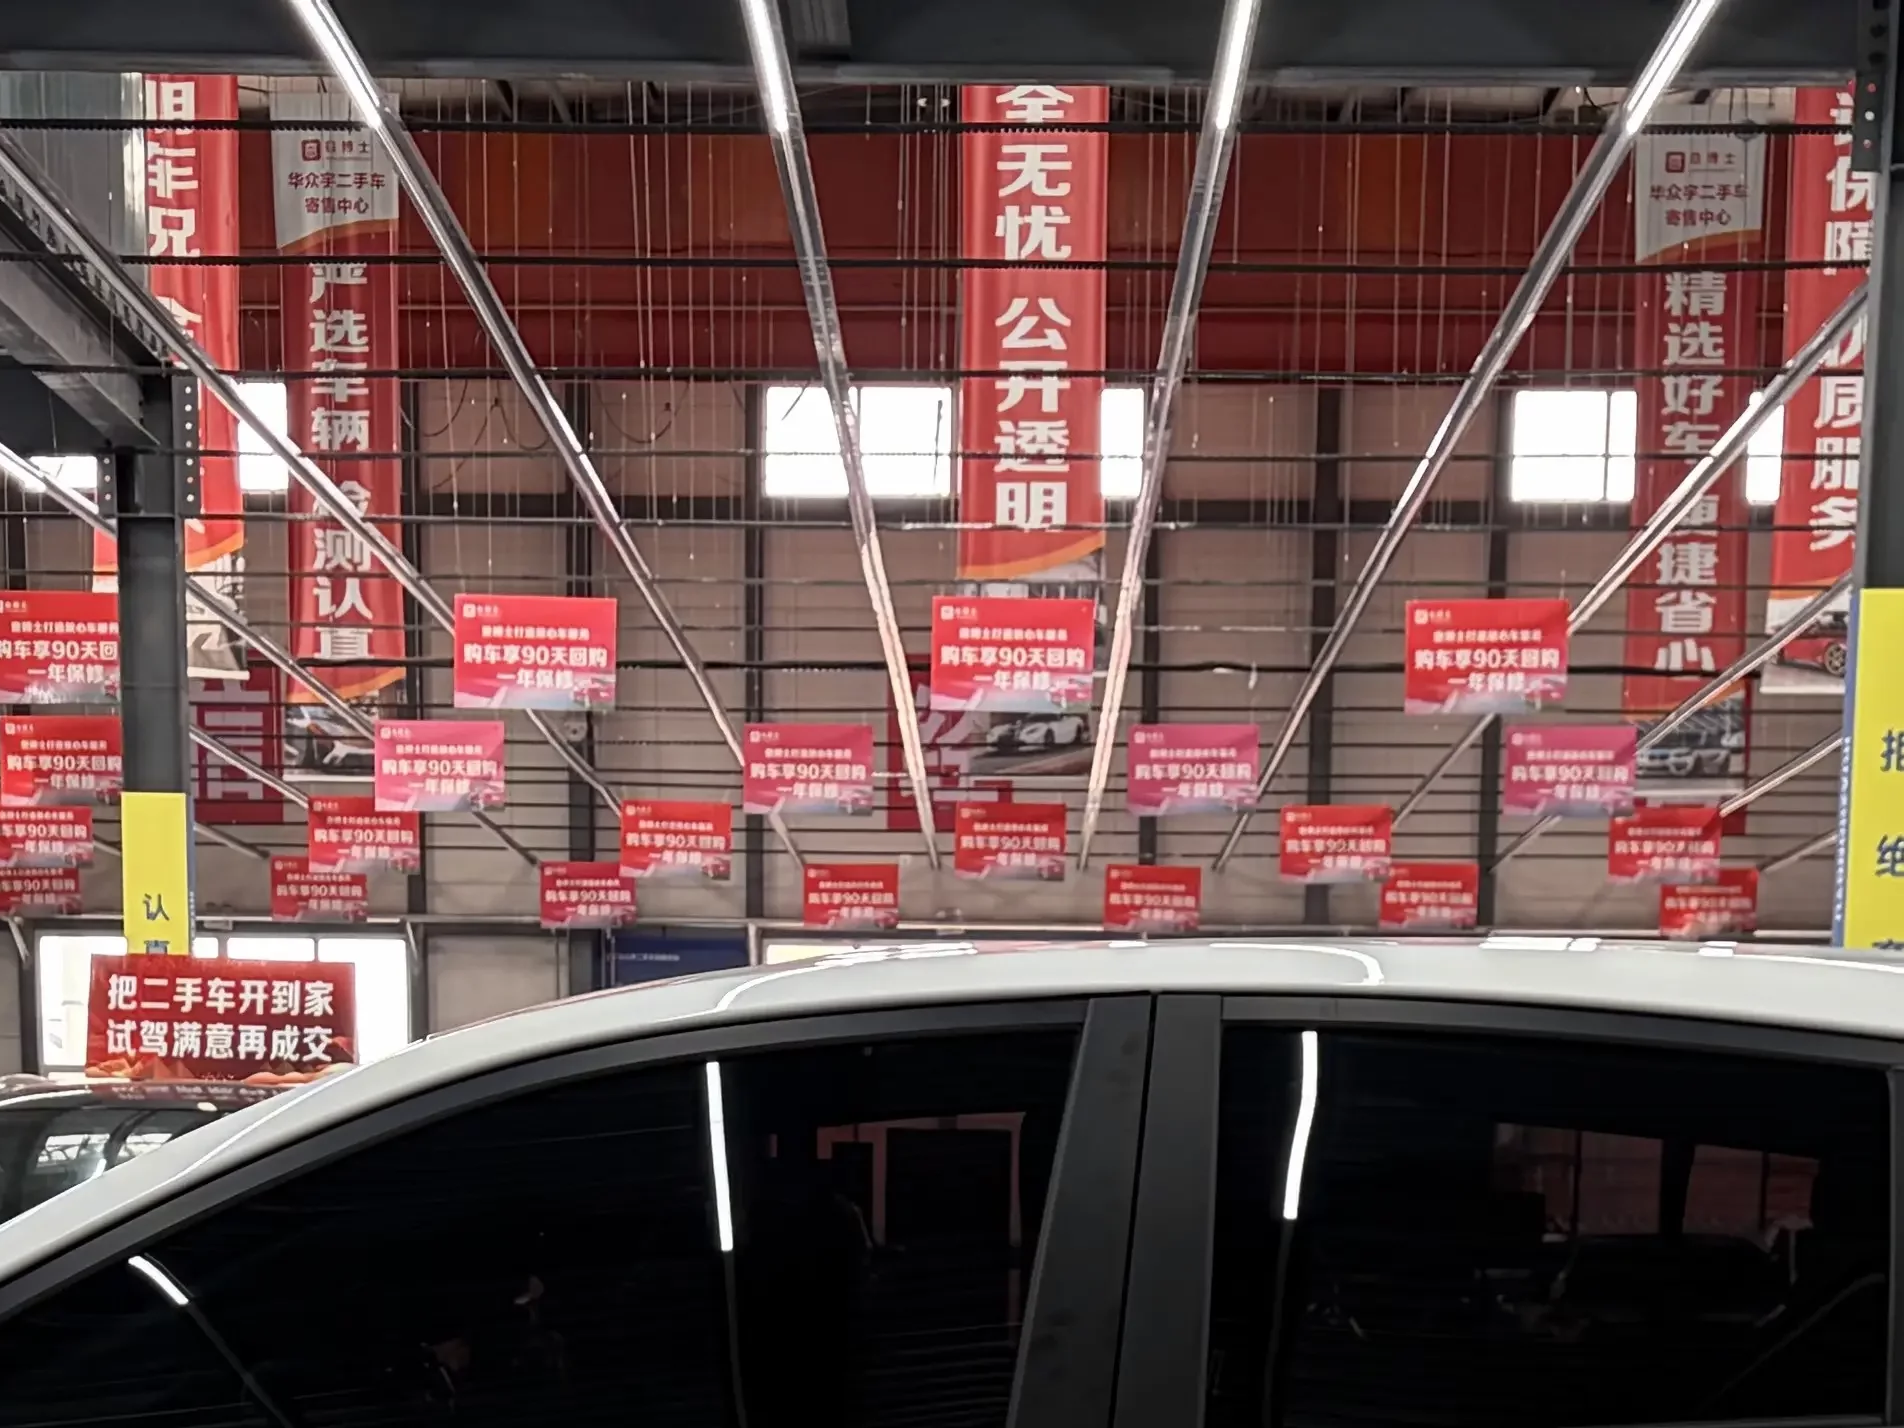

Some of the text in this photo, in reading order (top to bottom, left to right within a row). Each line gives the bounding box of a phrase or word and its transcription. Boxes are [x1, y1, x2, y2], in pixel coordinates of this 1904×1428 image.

[287, 171, 385, 190] 华众宇二手车
[309, 262, 370, 450] 严选车辆
[1660, 270, 1727, 465] 精选好车
[994, 297, 1072, 532] 公开透明
[463, 643, 608, 667] 购车享90天回购
[940, 646, 1086, 668] 购车享90天回购
[1414, 648, 1560, 669] 购车享90天回购
[108, 973, 335, 1017] 把二手车开到家
[106, 1019, 333, 1063] 试驾满意再成交
